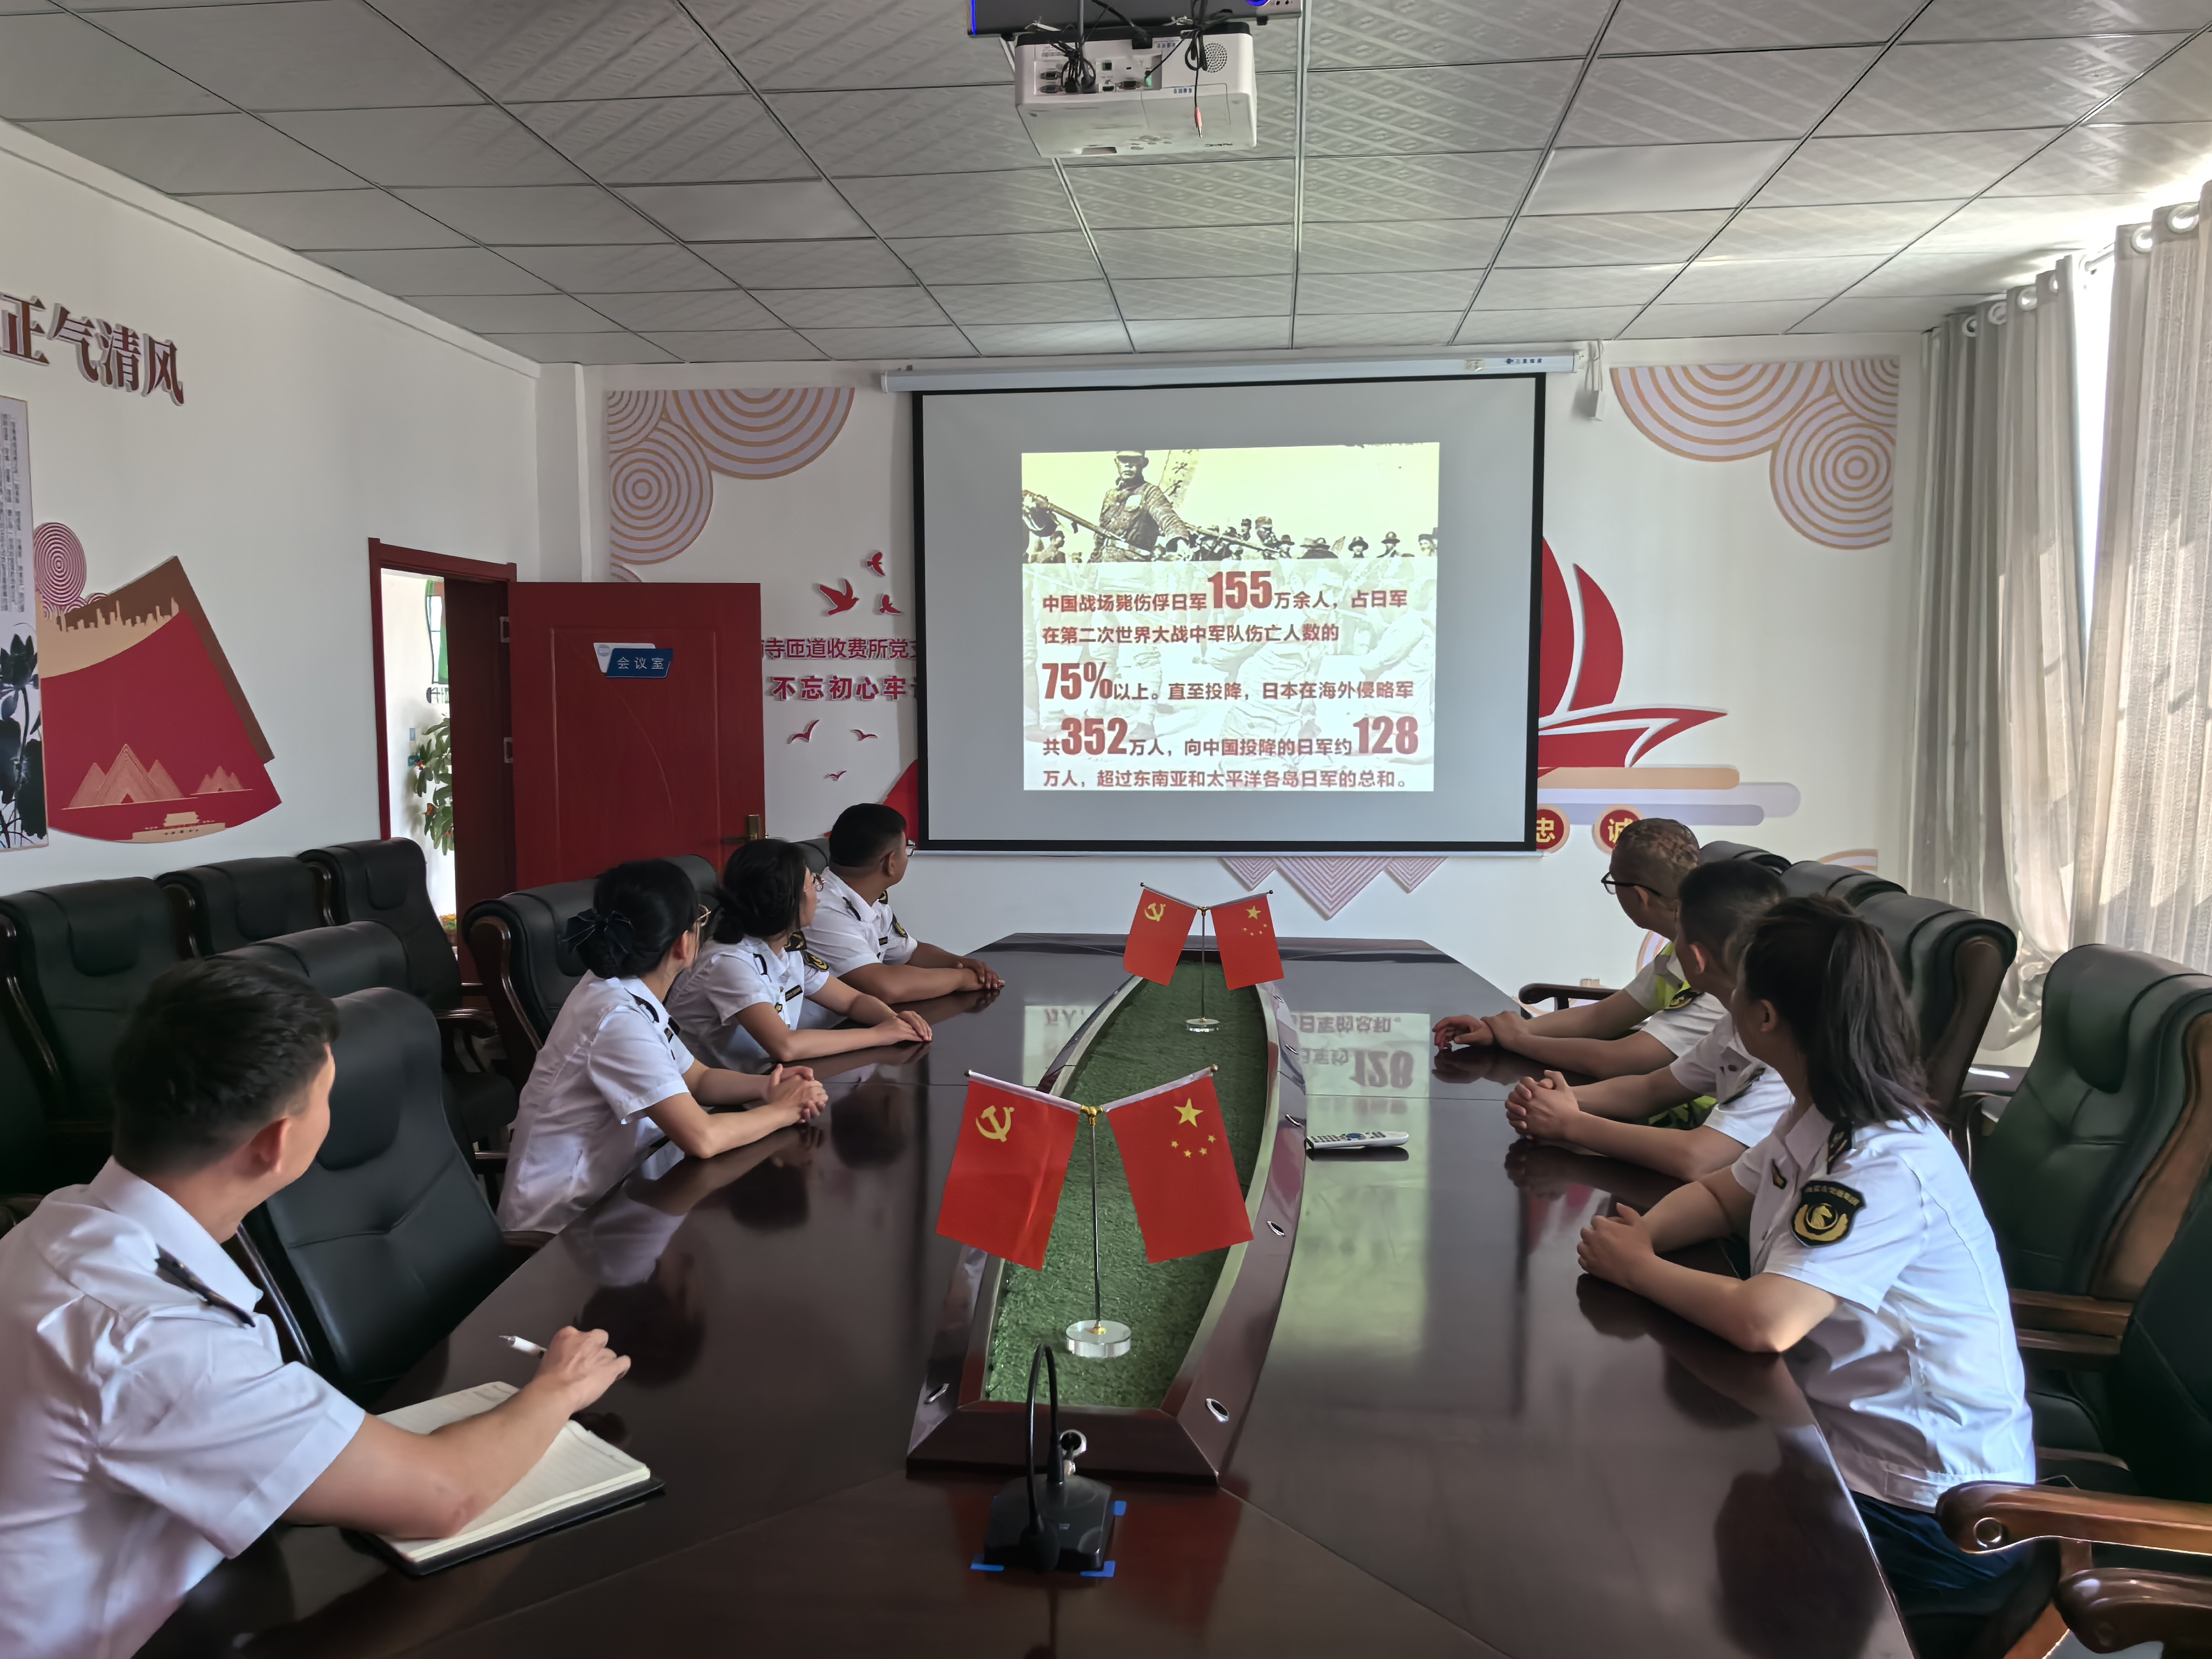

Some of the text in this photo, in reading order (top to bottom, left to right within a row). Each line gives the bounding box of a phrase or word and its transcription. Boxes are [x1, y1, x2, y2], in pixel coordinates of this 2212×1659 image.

[0, 292, 184, 406] 正气清风
[1042, 624, 1339, 644] 在第二次世界大战中军队伤亡人数的
[762, 637, 916, 659] 寺匝道收费所党
[617, 656, 664, 670] 会议室
[772, 675, 916, 700] 不忘初心牢
[1043, 716, 1419, 756] 共352万人，向中国投降的日军约128
[1043, 770, 1406, 788] 万人，超过东南亚和太平洋各岛日军的总和。
[1536, 817, 1555, 842] 忠
